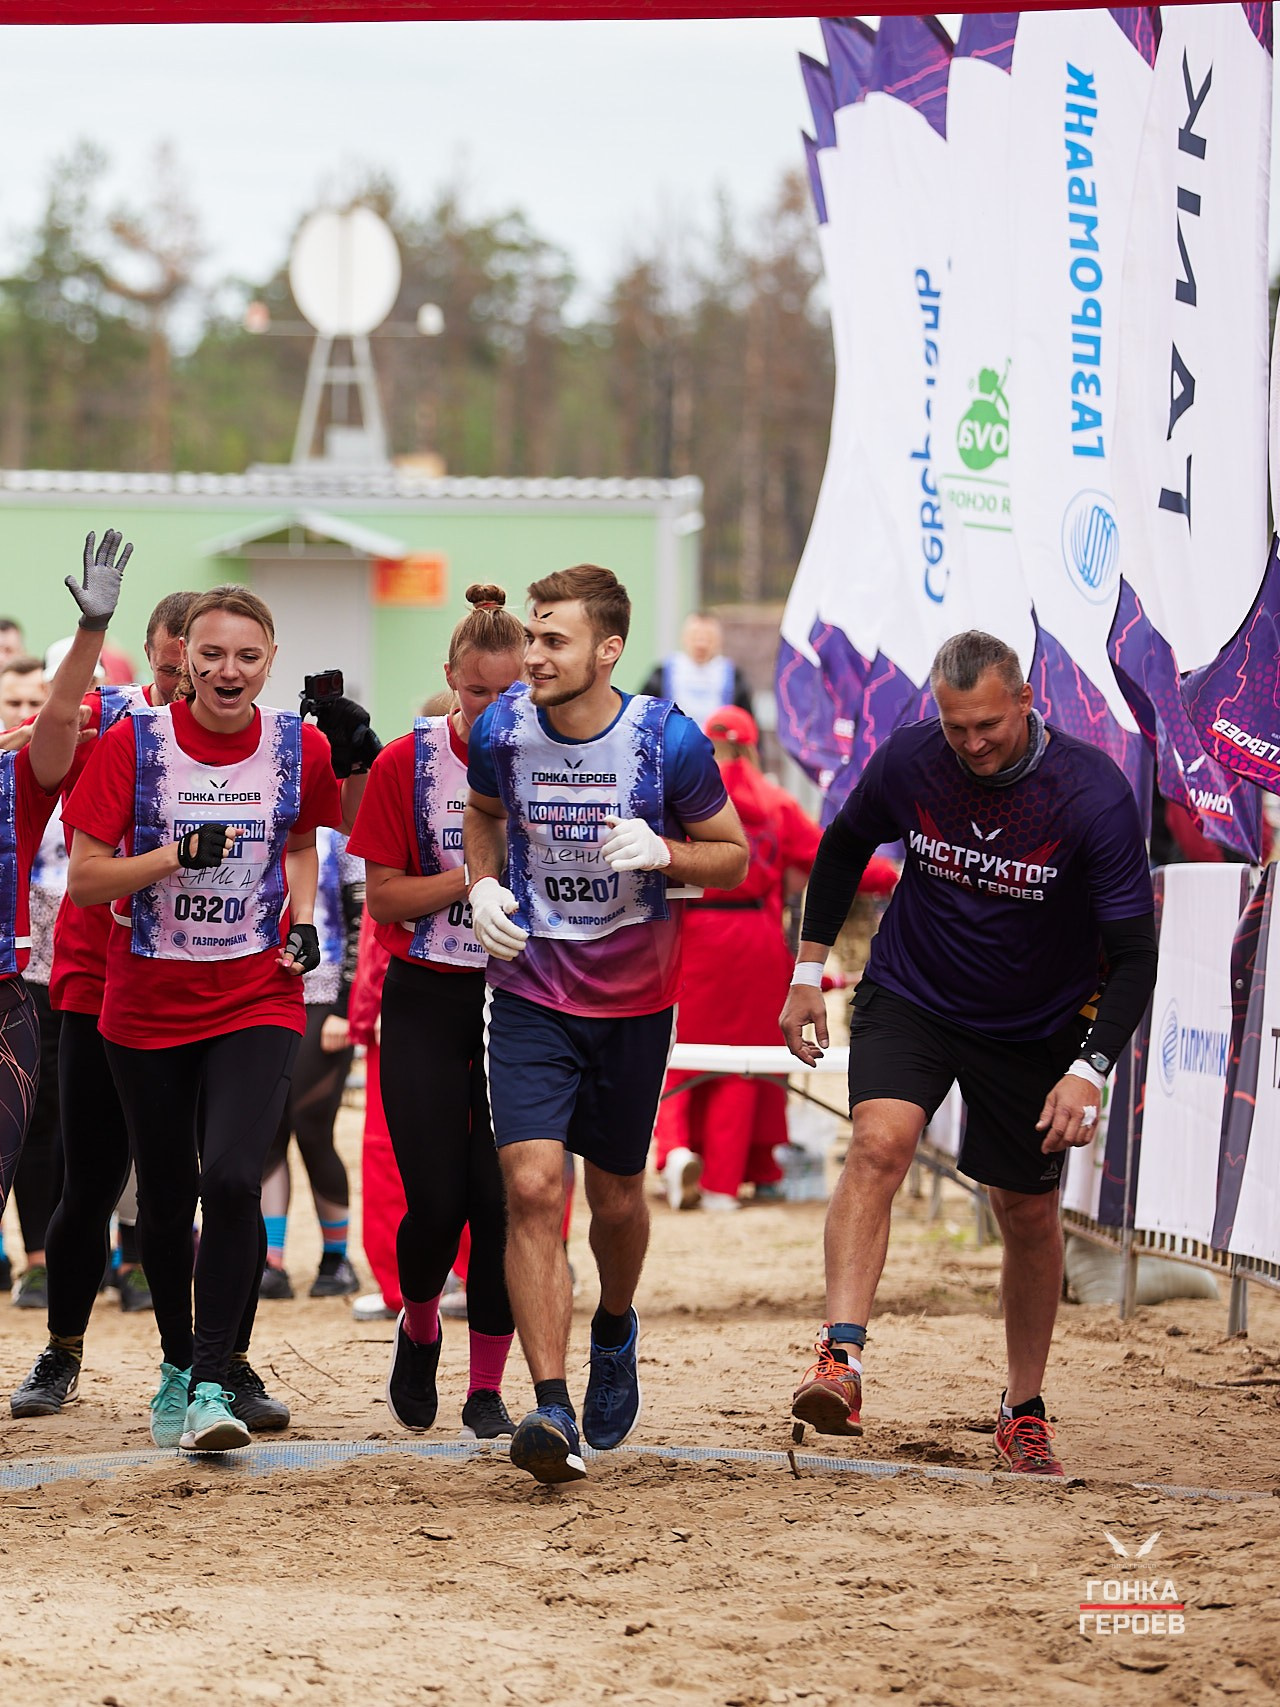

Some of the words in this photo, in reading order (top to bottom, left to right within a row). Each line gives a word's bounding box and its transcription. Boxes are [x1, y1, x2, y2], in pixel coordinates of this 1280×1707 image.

[532, 772, 568, 783] ГОНКА
[572, 773, 617, 783] ГЕРОЕВ
[178, 792, 215, 802] ГОНКА
[218, 792, 261, 802] ГЕРОЕВ
[554, 824, 596, 841] СТАРТ
[909, 830, 1058, 884] ИНСТРУКТОР
[545, 873, 620, 903] 03207
[919, 860, 972, 887] ГОНКА
[977, 878, 1044, 901] ГЕРОЕВ
[568, 906, 626, 926] ГАЗПРОМБАНК
[192, 933, 248, 947] ГАЗПРОМБАНК
